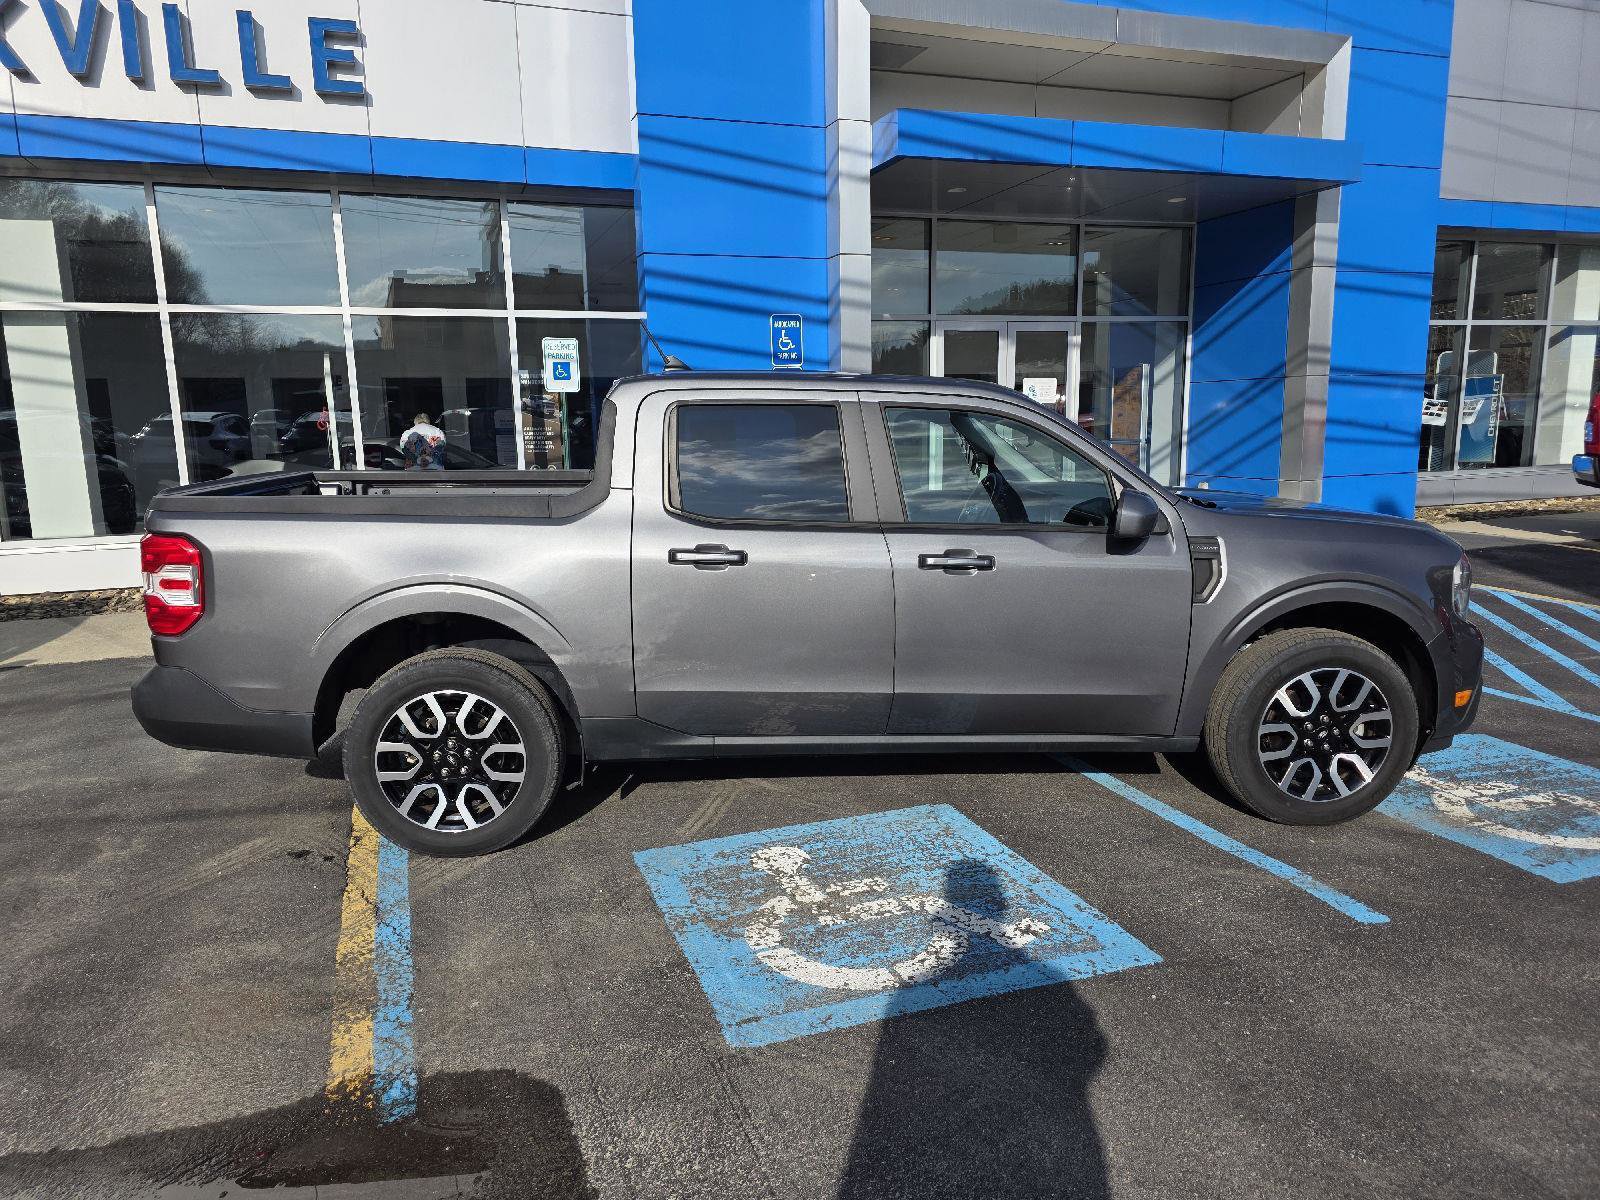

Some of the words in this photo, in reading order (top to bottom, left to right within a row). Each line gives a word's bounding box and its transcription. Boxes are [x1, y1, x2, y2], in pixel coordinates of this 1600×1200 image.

[546, 343, 576, 351] RESERVED
[547, 352, 575, 360] PARKING
[1487, 378, 1500, 437] CHEVROLET
